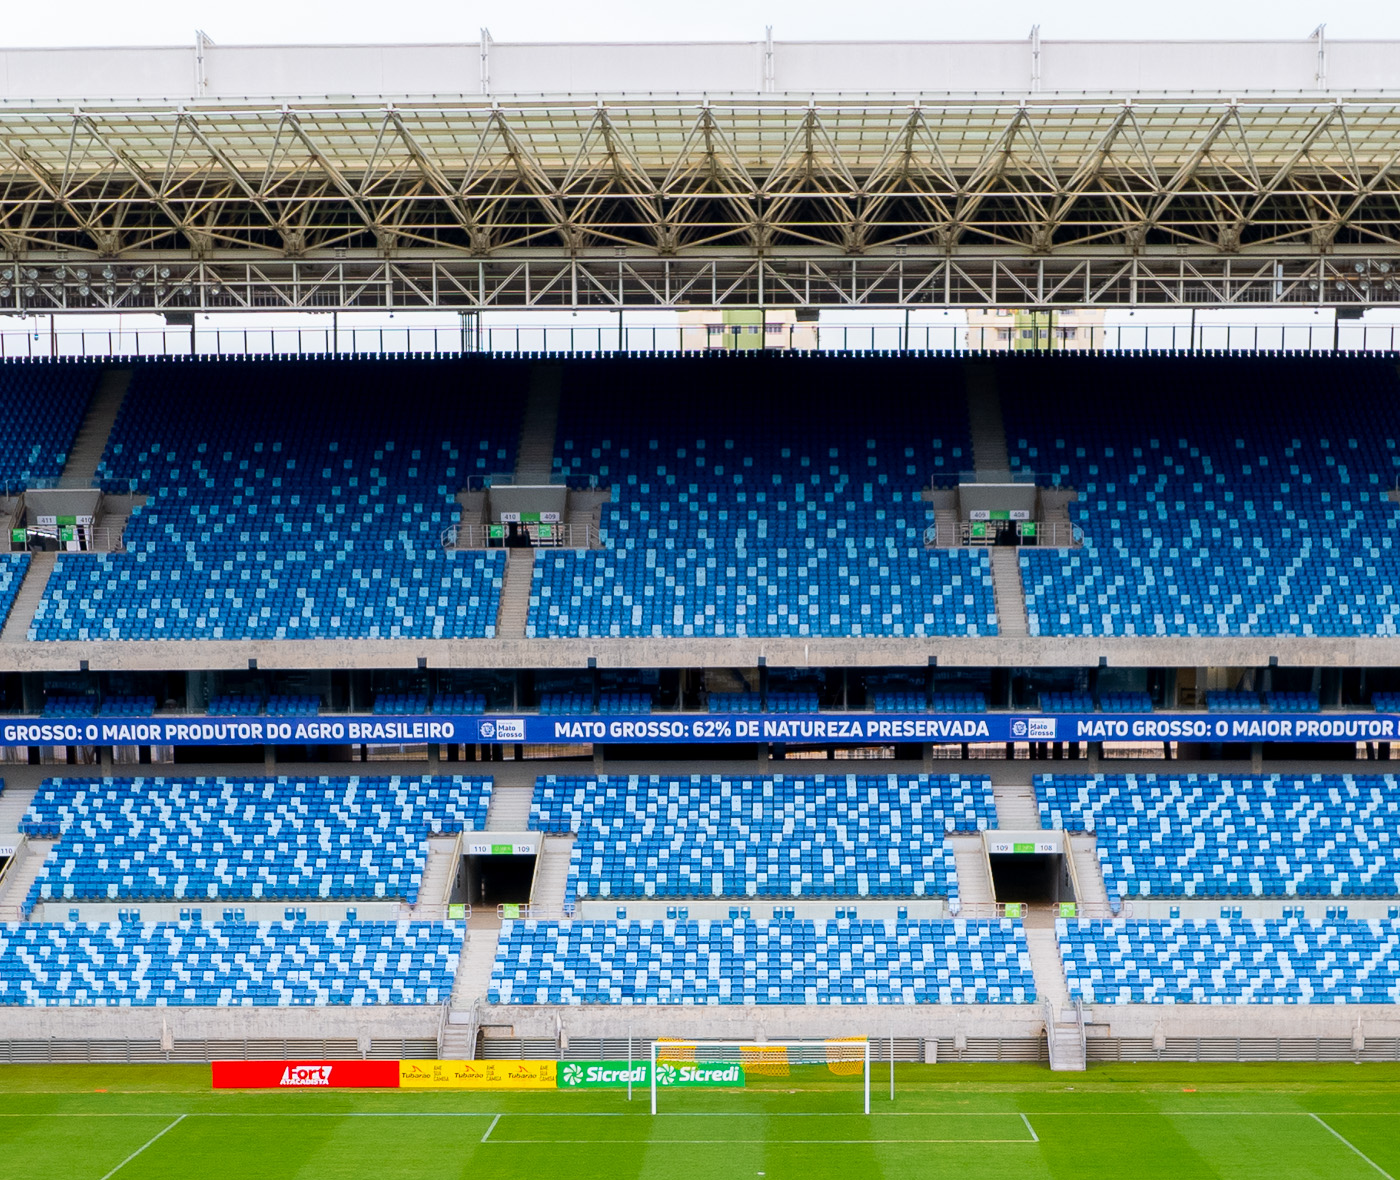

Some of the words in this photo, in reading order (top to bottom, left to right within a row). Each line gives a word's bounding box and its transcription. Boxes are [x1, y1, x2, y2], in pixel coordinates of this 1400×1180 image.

[4, 725, 82, 741] GROSSO:
[85, 724, 98, 740] O
[102, 724, 161, 740] MAIOR
[165, 723, 263, 740] PRODUTOR
[267, 723, 291, 739] DO
[295, 723, 344, 739] AGRO
[348, 722, 454, 739] BRASILEIRO
[554, 722, 606, 738] MATO
[610, 721, 689, 737] GROSSO:
[692, 721, 731, 737] 62%
[735, 721, 759, 736] DE
[764, 720, 863, 737] NATUREZA
[867, 720, 990, 737] PRESERVADA
[1077, 720, 1129, 737] MATO
[1132, 720, 1211, 737] GROSSO:
[1215, 720, 1228, 737] O
[1232, 720, 1292, 736] MAIOR
[1295, 720, 1394, 736] PRODUTOR
[287, 1066, 327, 1080] Fort
[586, 1066, 647, 1082] Sicredi
[678, 1066, 739, 1082] Sicredi
